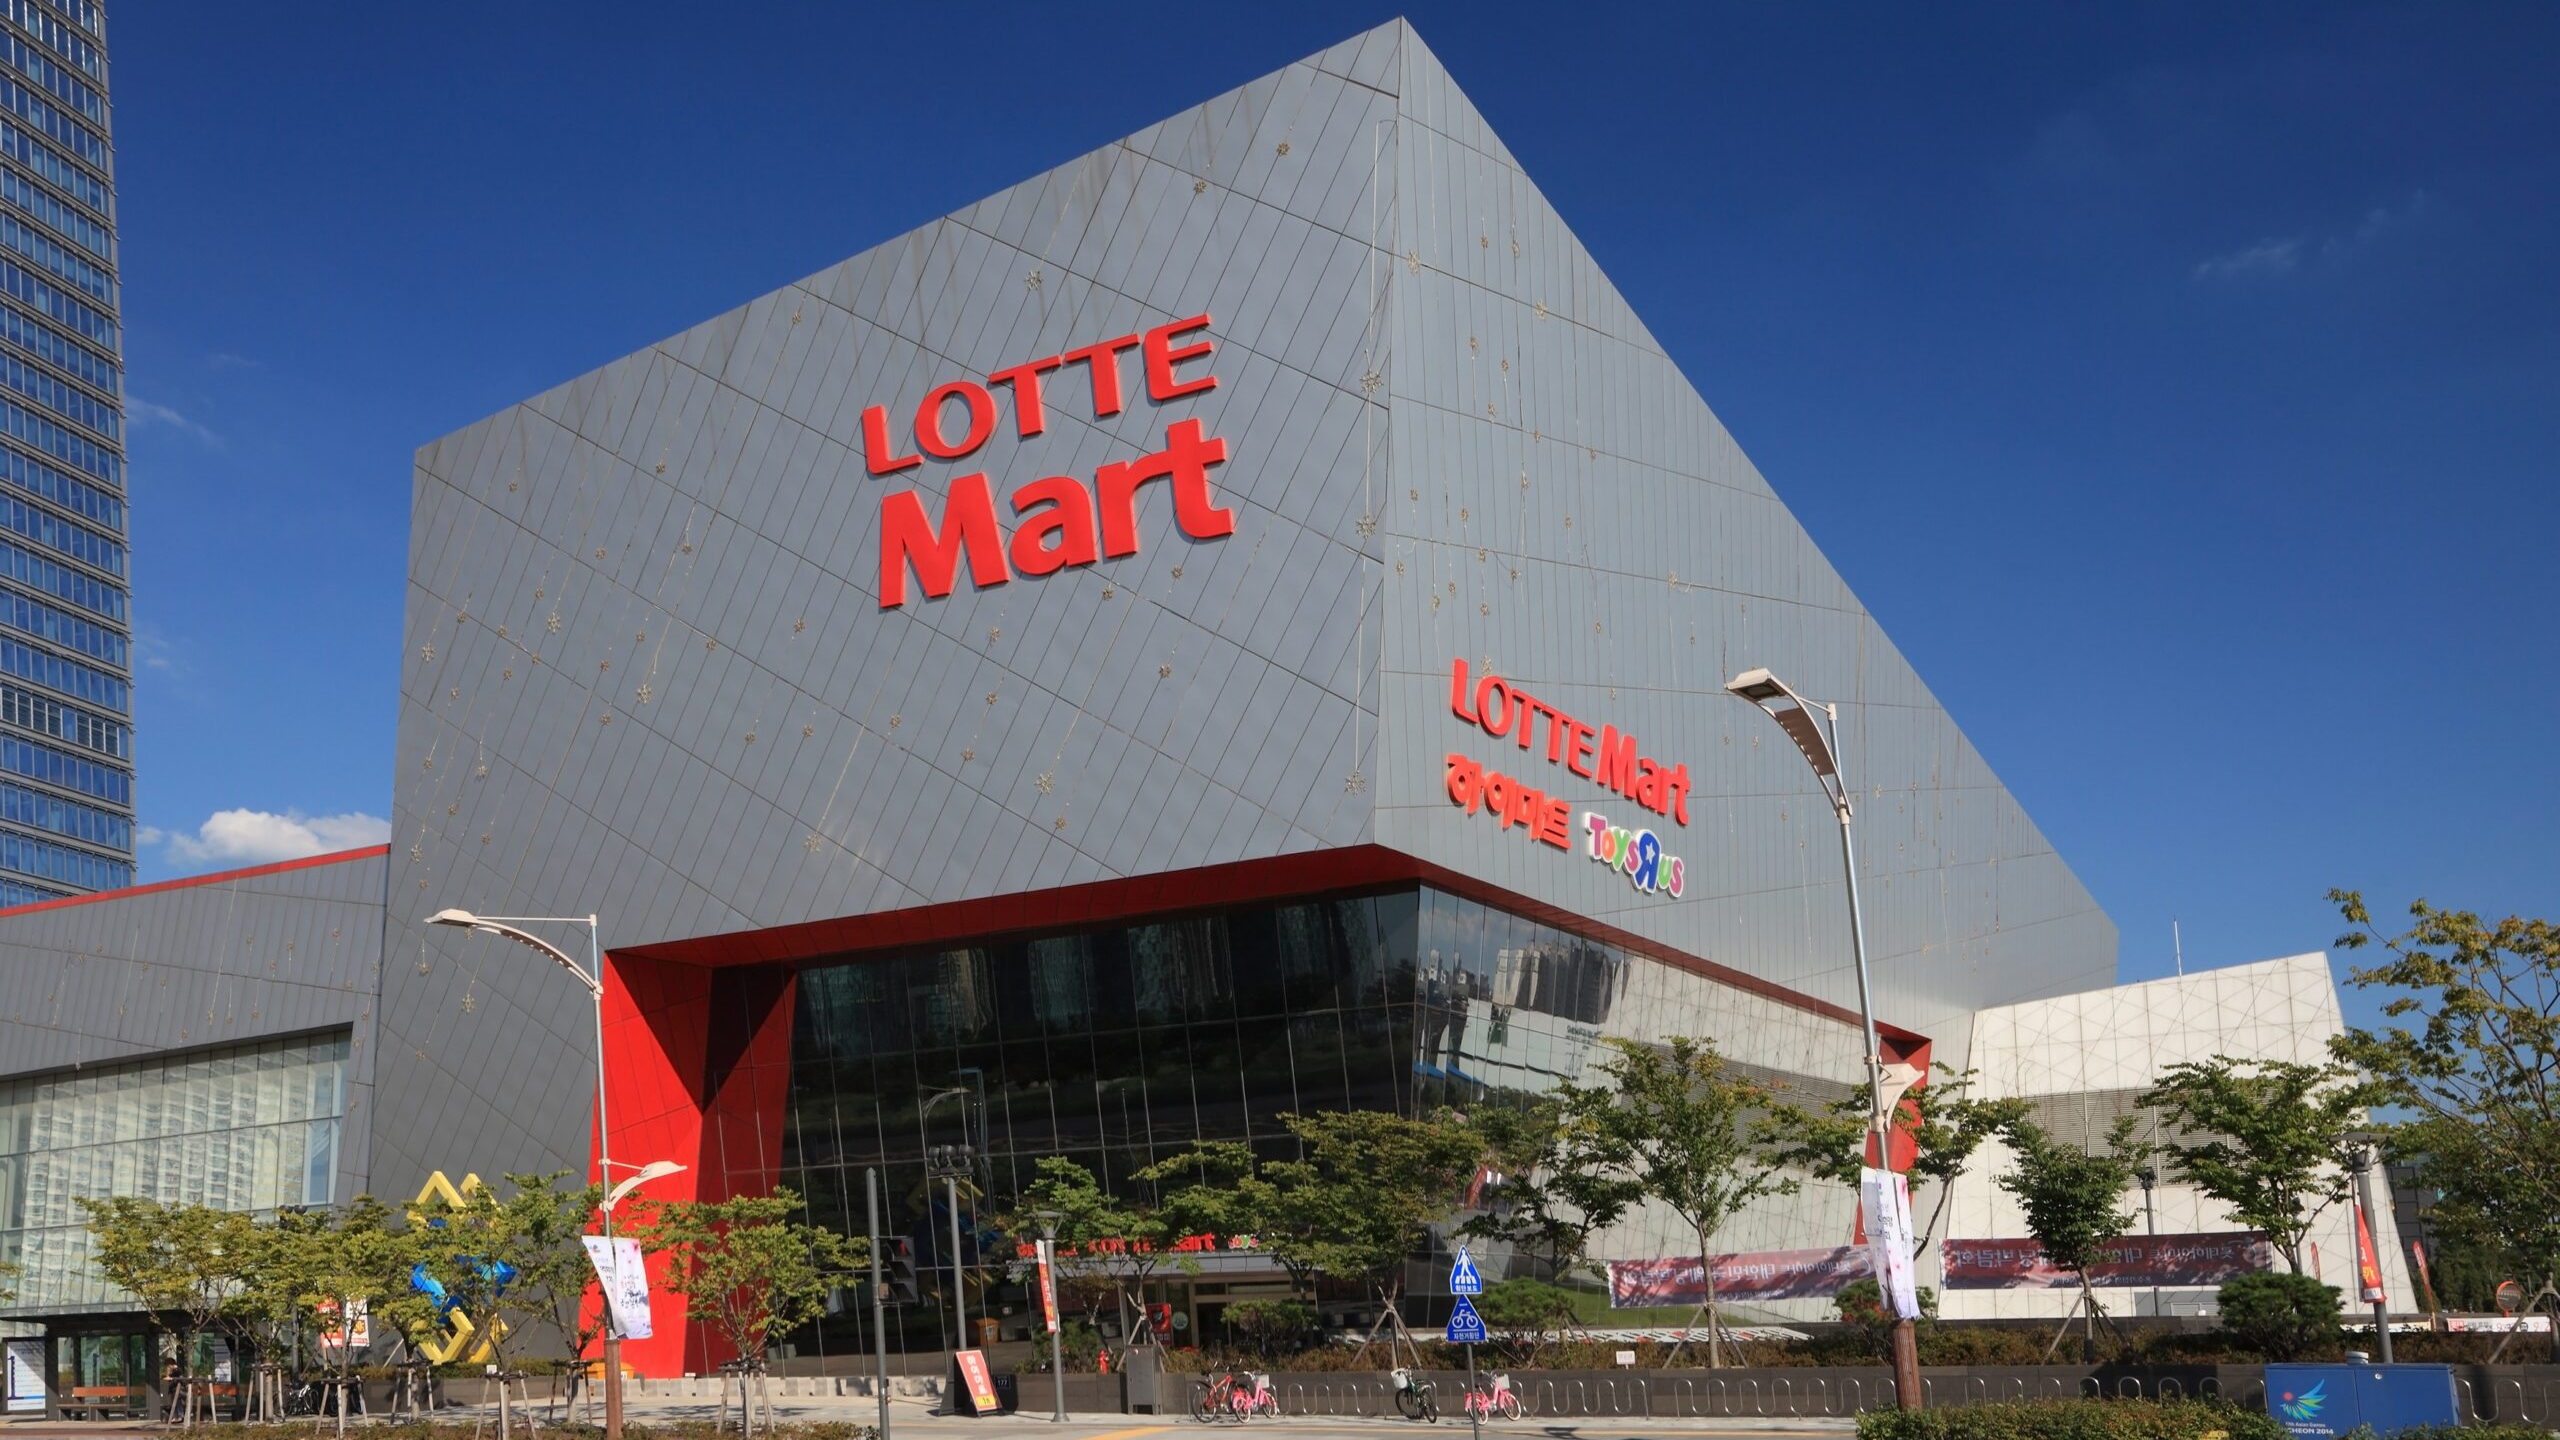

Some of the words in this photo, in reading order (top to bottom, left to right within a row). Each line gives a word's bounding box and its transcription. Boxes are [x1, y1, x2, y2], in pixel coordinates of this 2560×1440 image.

[862, 313, 1219, 475] LOTTE
[879, 418, 1235, 610] Mart
[1451, 658, 1596, 778] LOTTE
[1596, 724, 1691, 827] Mart
[1447, 753, 1572, 852] 하이마트
[1168, 1232, 1215, 1251] art
[966, 1355, 988, 1395] 하이마트
[1453, 1331, 1480, 1340] 자전거횡단
